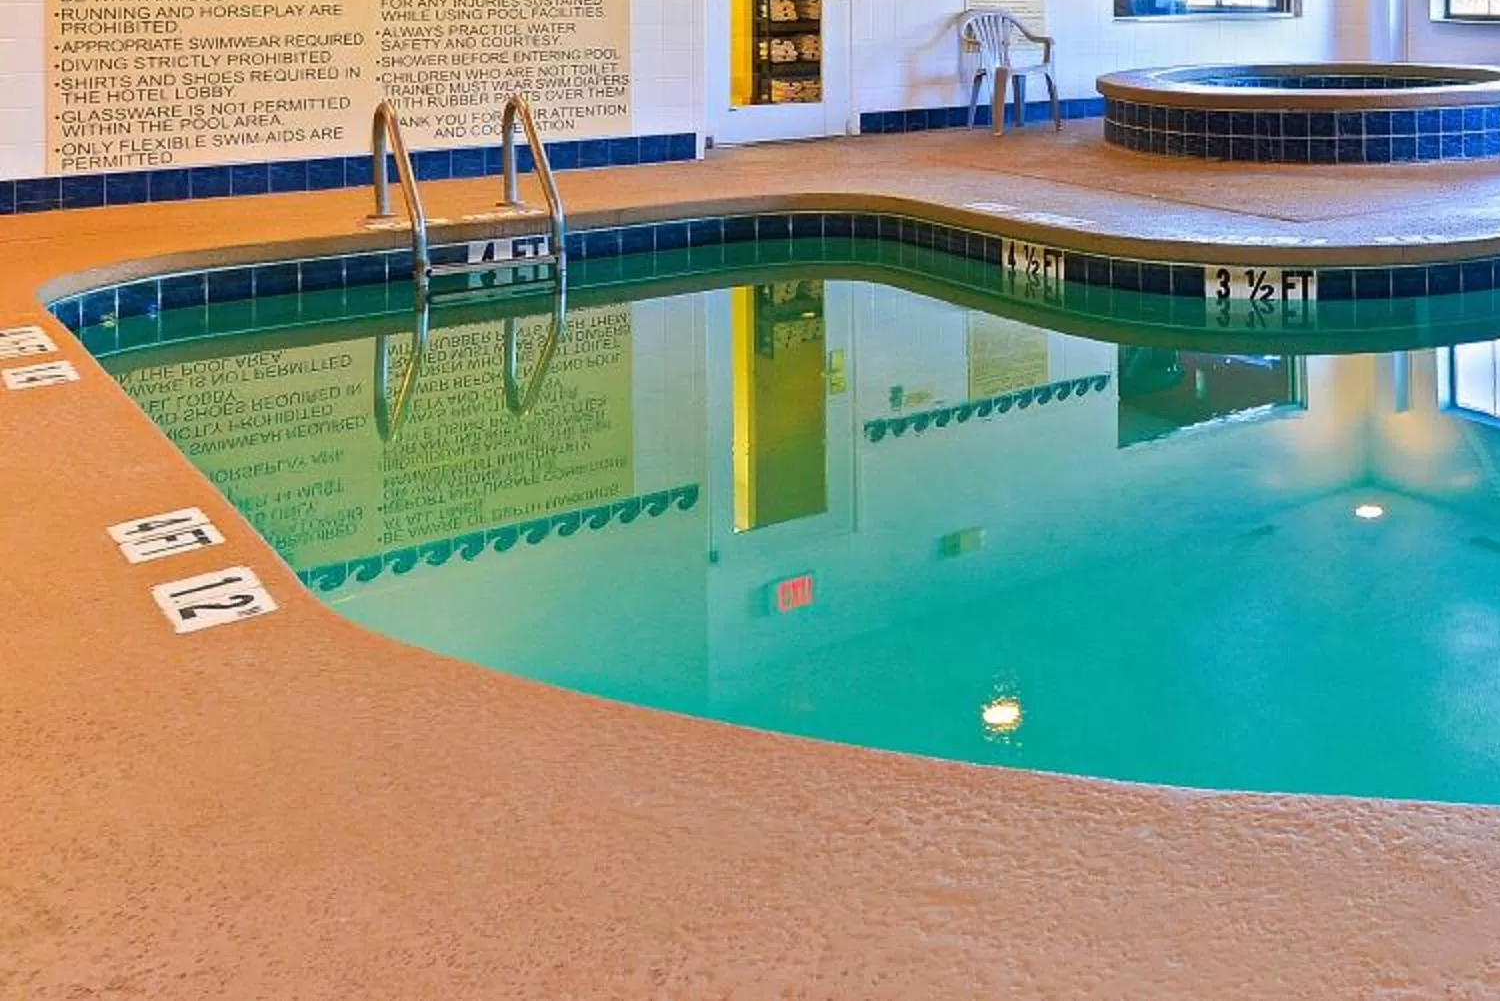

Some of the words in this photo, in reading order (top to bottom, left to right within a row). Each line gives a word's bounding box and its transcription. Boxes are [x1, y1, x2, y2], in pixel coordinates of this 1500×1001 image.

[62, 7, 150, 20] RUNNING
[156, 7, 194, 19] AND
[201, 5, 304, 18] HORSEPLAY
[309, 5, 342, 16] ARE
[381, 10, 430, 22] WHILE
[435, 9, 482, 21] USING
[487, 8, 528, 19] POOL
[381, 26, 444, 38] ALWAYS
[449, 24, 522, 37] PRACTICE
[528, 23, 575, 34] WATER
[62, 39, 182, 54] APPROPRIATE
[189, 36, 280, 50] SWIMWEAR
[381, 39, 440, 51] SAFETY
[444, 38, 477, 49] AND
[62, 58, 127, 72] DIVING
[134, 55, 220, 69] STRICTLY
[381, 55, 447, 68] SHOWER
[452, 54, 508, 65] BEFORE
[514, 51, 581, 63] ENTERING
[585, 49, 620, 60] POOL
[62, 76, 131, 90] SHIRTS
[137, 74, 175, 86] AND
[183, 72, 244, 85] SHOES
[251, 68, 338, 82] REQUIRED
[345, 67, 360, 78] IN
[381, 71, 460, 84] CHILDREN
[466, 69, 500, 80] WHO
[504, 68, 533, 77] ARE
[538, 65, 566, 76] NOT
[571, 63, 618, 75] TOILET
[383, 84, 445, 96] TRAINED
[450, 82, 489, 94] MUST
[492, 80, 531, 91] WEAR
[536, 77, 571, 89] SWIM
[62, 92, 99, 104] THE
[105, 89, 168, 103] HOTEL
[427, 94, 489, 107] RUBBER
[545, 90, 582, 101] OVER
[62, 105, 182, 124] GLASSWARE
[189, 104, 203, 116] IS
[211, 102, 248, 115] NOT
[254, 98, 350, 113] PERMITTED
[434, 114, 466, 125] YOU
[471, 112, 501, 124] FOR
[552, 104, 627, 117] ATTENTION
[62, 124, 131, 137] WITHIN
[139, 121, 173, 133] THE
[180, 118, 227, 131] POOL
[434, 127, 466, 138] AND
[470, 119, 575, 136] COOEATION
[62, 142, 113, 156] ONLY
[120, 136, 206, 152] FLEXIBLE
[213, 132, 259, 147] SWIM
[266, 130, 305, 143] AIDS
[311, 127, 343, 140] ARE
[512, 237, 545, 256] FT
[1044, 248, 1064, 280] FT
[1216, 268, 1231, 299] 3
[1282, 270, 1314, 301] FT
